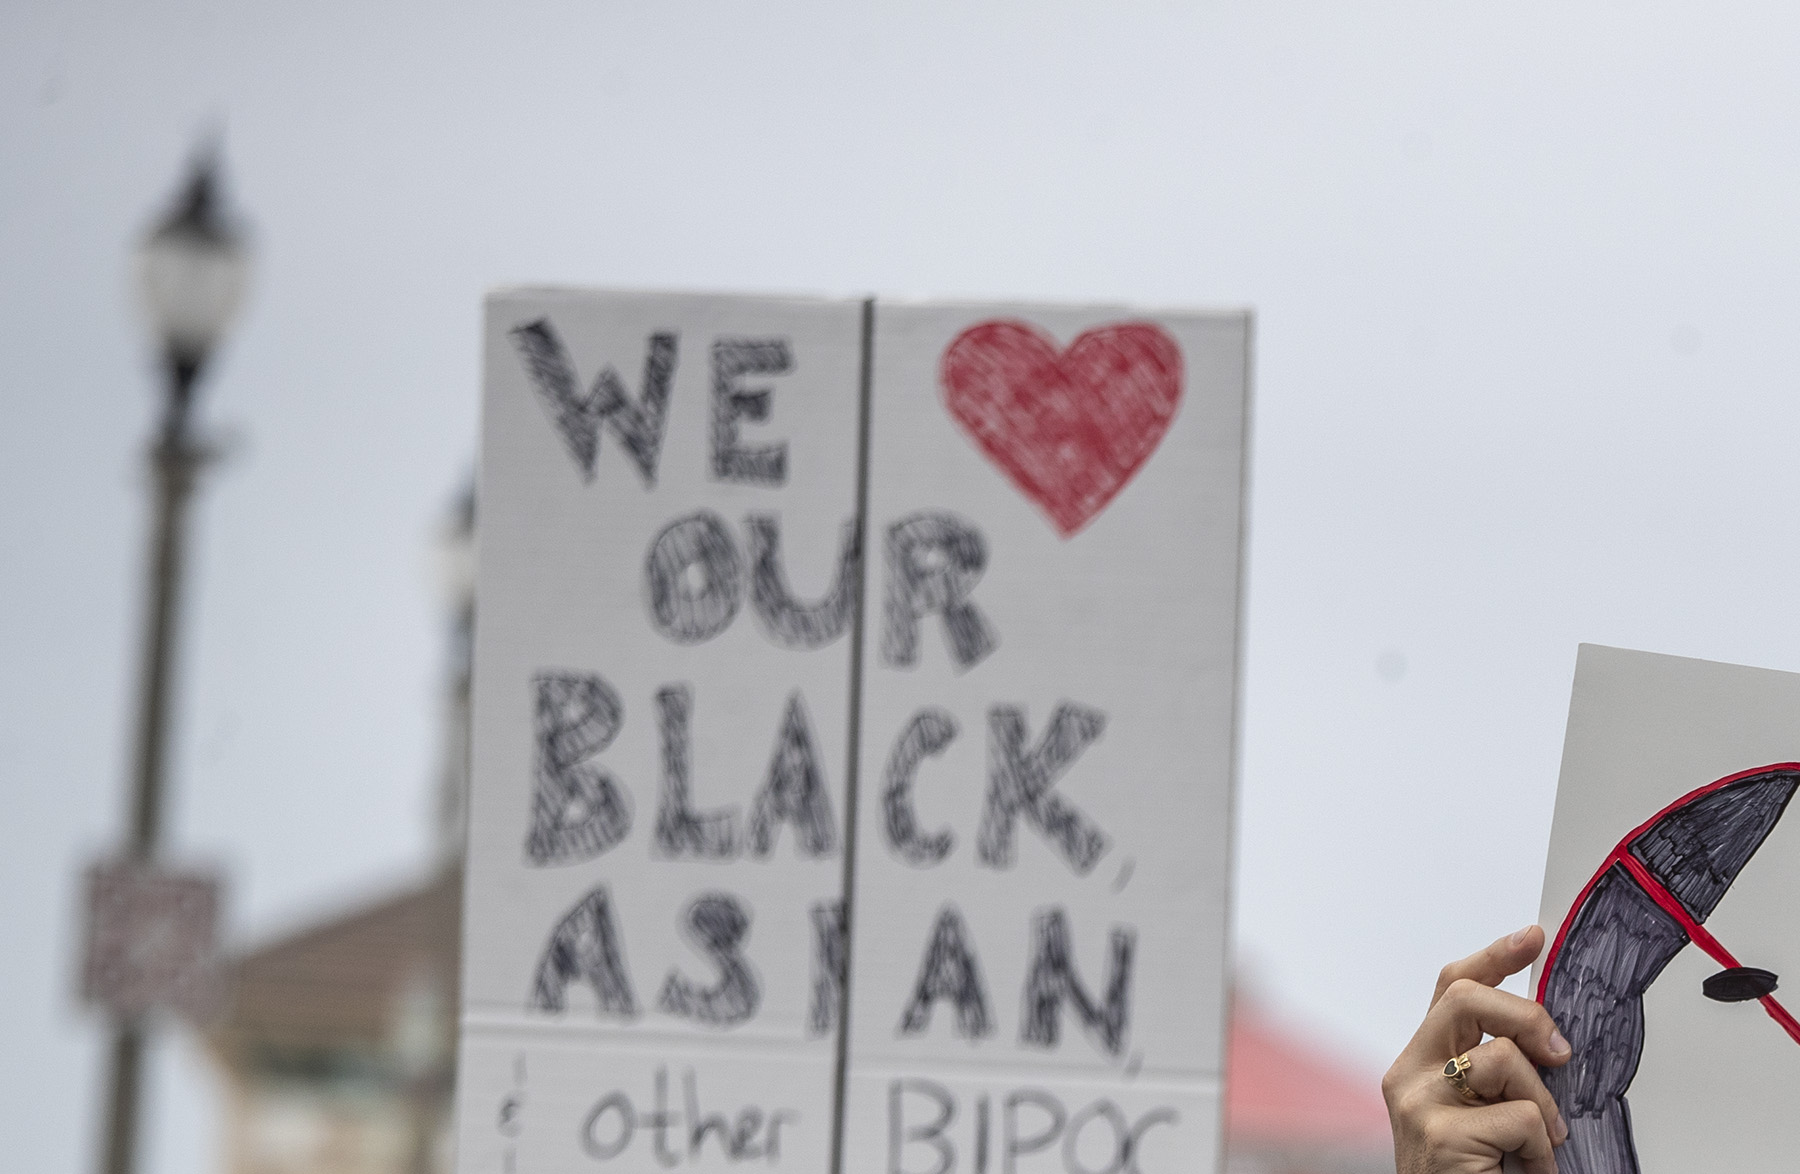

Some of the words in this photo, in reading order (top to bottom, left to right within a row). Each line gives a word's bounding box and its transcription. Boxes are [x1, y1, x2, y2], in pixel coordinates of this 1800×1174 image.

[509, 318, 796, 488] WE
[642, 507, 998, 672] OUR
[581, 1065, 793, 1167] other
